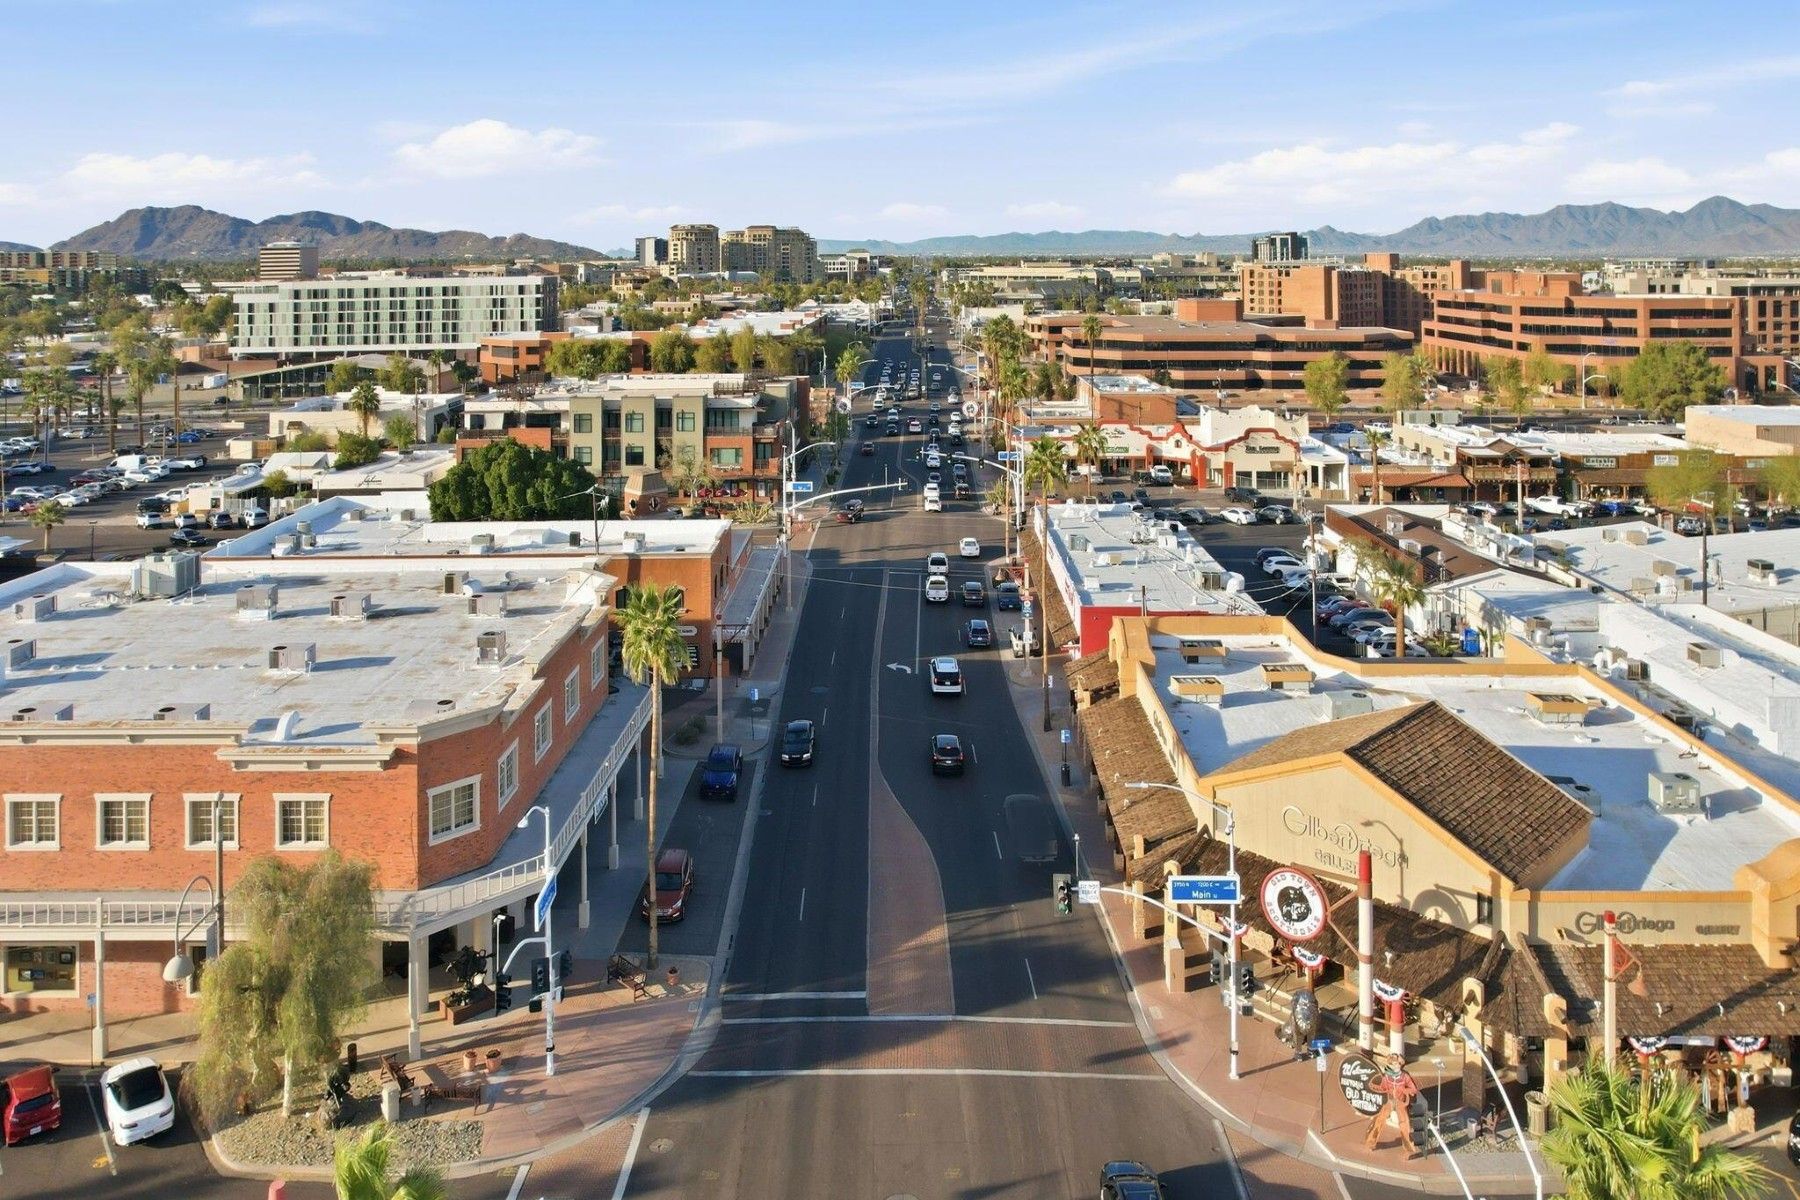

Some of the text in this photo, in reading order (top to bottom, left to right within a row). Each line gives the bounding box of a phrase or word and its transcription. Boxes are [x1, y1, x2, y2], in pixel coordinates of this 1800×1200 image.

[1270, 874, 1317, 896] OLD TOWN
[1191, 890, 1211, 899] Main
